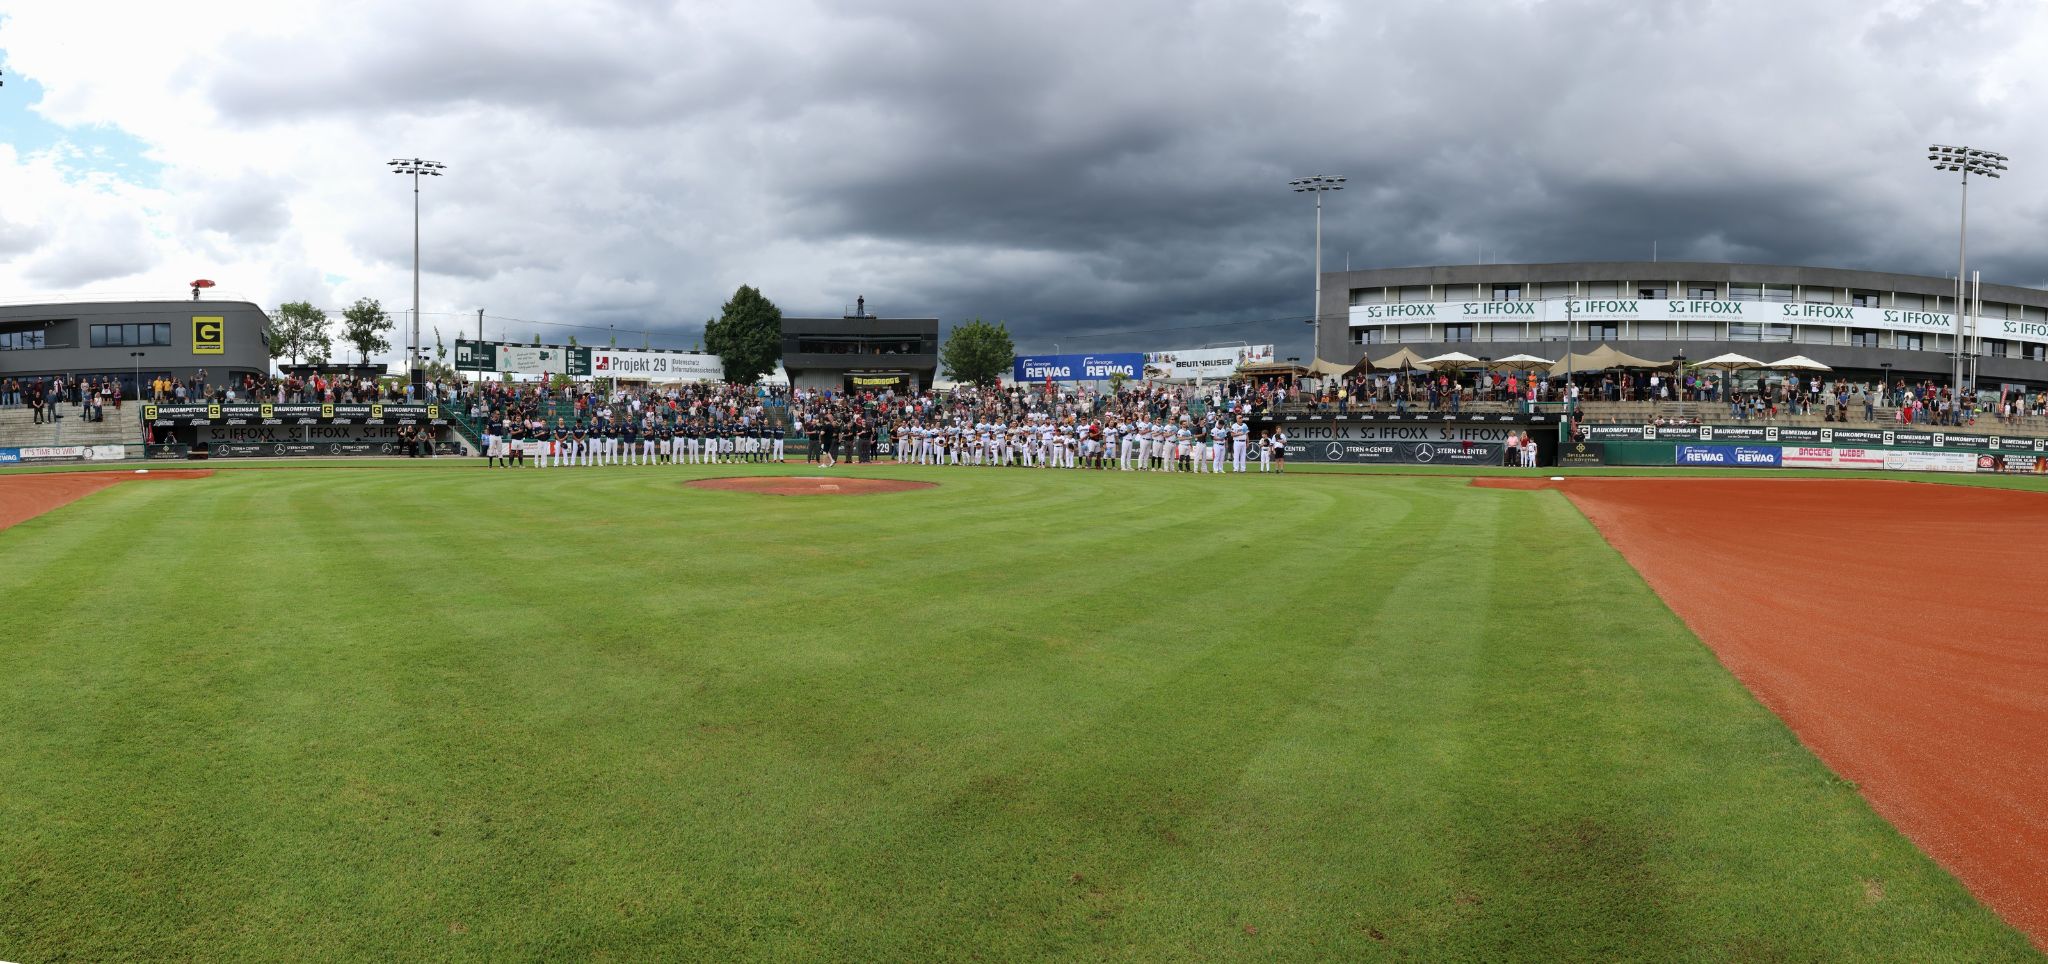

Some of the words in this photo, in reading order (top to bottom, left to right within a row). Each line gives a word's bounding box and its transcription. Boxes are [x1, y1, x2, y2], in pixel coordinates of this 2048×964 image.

[1367, 305, 1382, 318] SG
[1386, 303, 1435, 317] IFFOXX
[1463, 302, 1479, 315] SG
[1483, 302, 1535, 315] IFFOXX
[1585, 300, 1639, 313] IFFOXX
[1668, 300, 1685, 313] SG
[1689, 301, 1742, 314] IFFOXX
[1783, 303, 1799, 316] SG
[1803, 304, 1854, 319] IFFOXX
[1883, 310, 1899, 322] SG
[1903, 312, 1950, 326] IFFOXX
[2003, 321, 2017, 333] SG
[2020, 322, 2048, 337] IFFO
[612, 356, 650, 373] Projekt
[653, 357, 667, 372] 29
[1086, 364, 1134, 377] REWAG
[1025, 366, 1071, 378] REWAG
[229, 427, 276, 439] IFFOXX
[1287, 426, 1300, 439] SG
[1360, 426, 1375, 439] SG
[1380, 427, 1428, 440] IFFOXX
[1834, 431, 1882, 439] BAUKOMPETENZ
[36, 448, 51, 456] TIME
[52, 447, 61, 455] TO
[1686, 453, 1724, 462] REWAG
[1737, 453, 1774, 463] REWAG
[1839, 449, 1865, 458] WEBER
